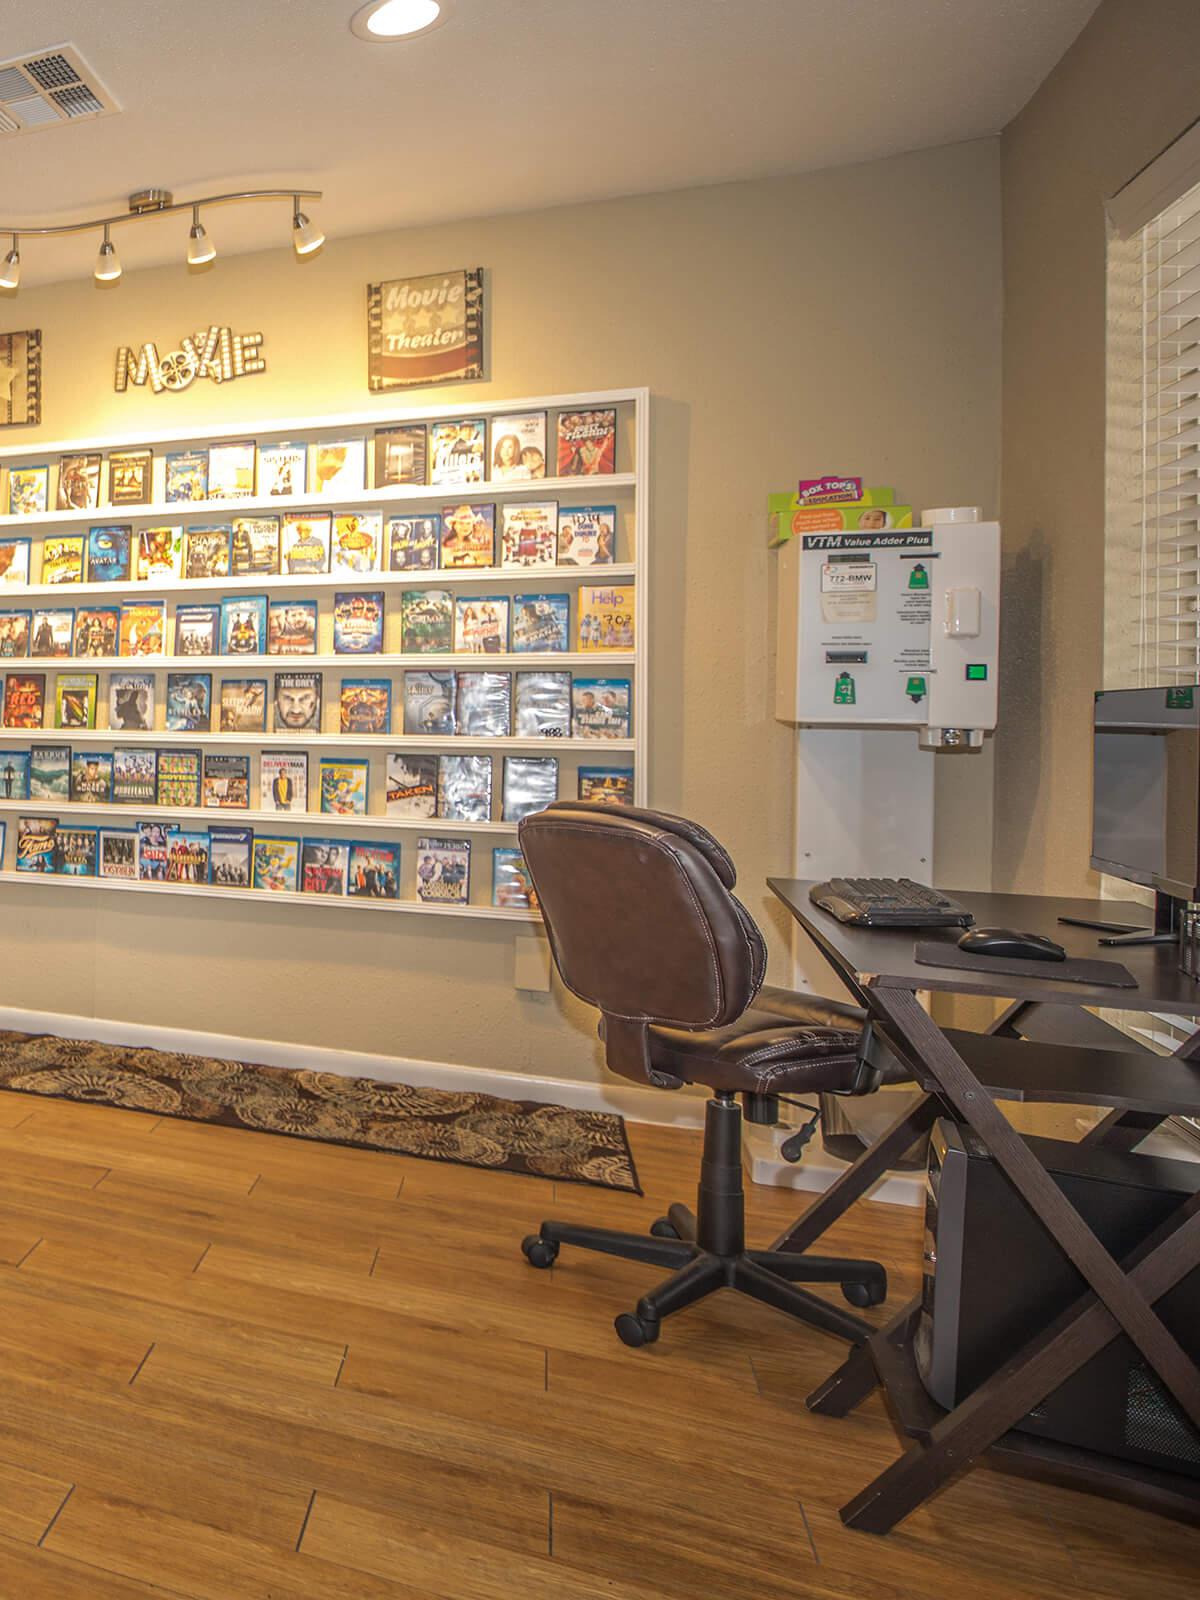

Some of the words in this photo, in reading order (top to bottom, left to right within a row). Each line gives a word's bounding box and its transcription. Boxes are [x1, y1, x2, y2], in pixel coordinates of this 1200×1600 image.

[385, 279, 464, 311] Movie
[386, 328, 464, 352] Theater
[114, 325, 266, 394] MOVIE
[801, 483, 823, 497] BOX
[807, 536, 841, 548] VTM
[844, 537, 872, 546] Value
[872, 536, 905, 546] Adder
[906, 535, 929, 545] Plus
[90, 556, 116, 566] AVATAR
[830, 574, 872, 583] 772-BMW
[592, 590, 625, 607] Help
[10, 692, 36, 705] RED
[391, 785, 433, 799] TAKEN
[18, 835, 55, 858] Fame
